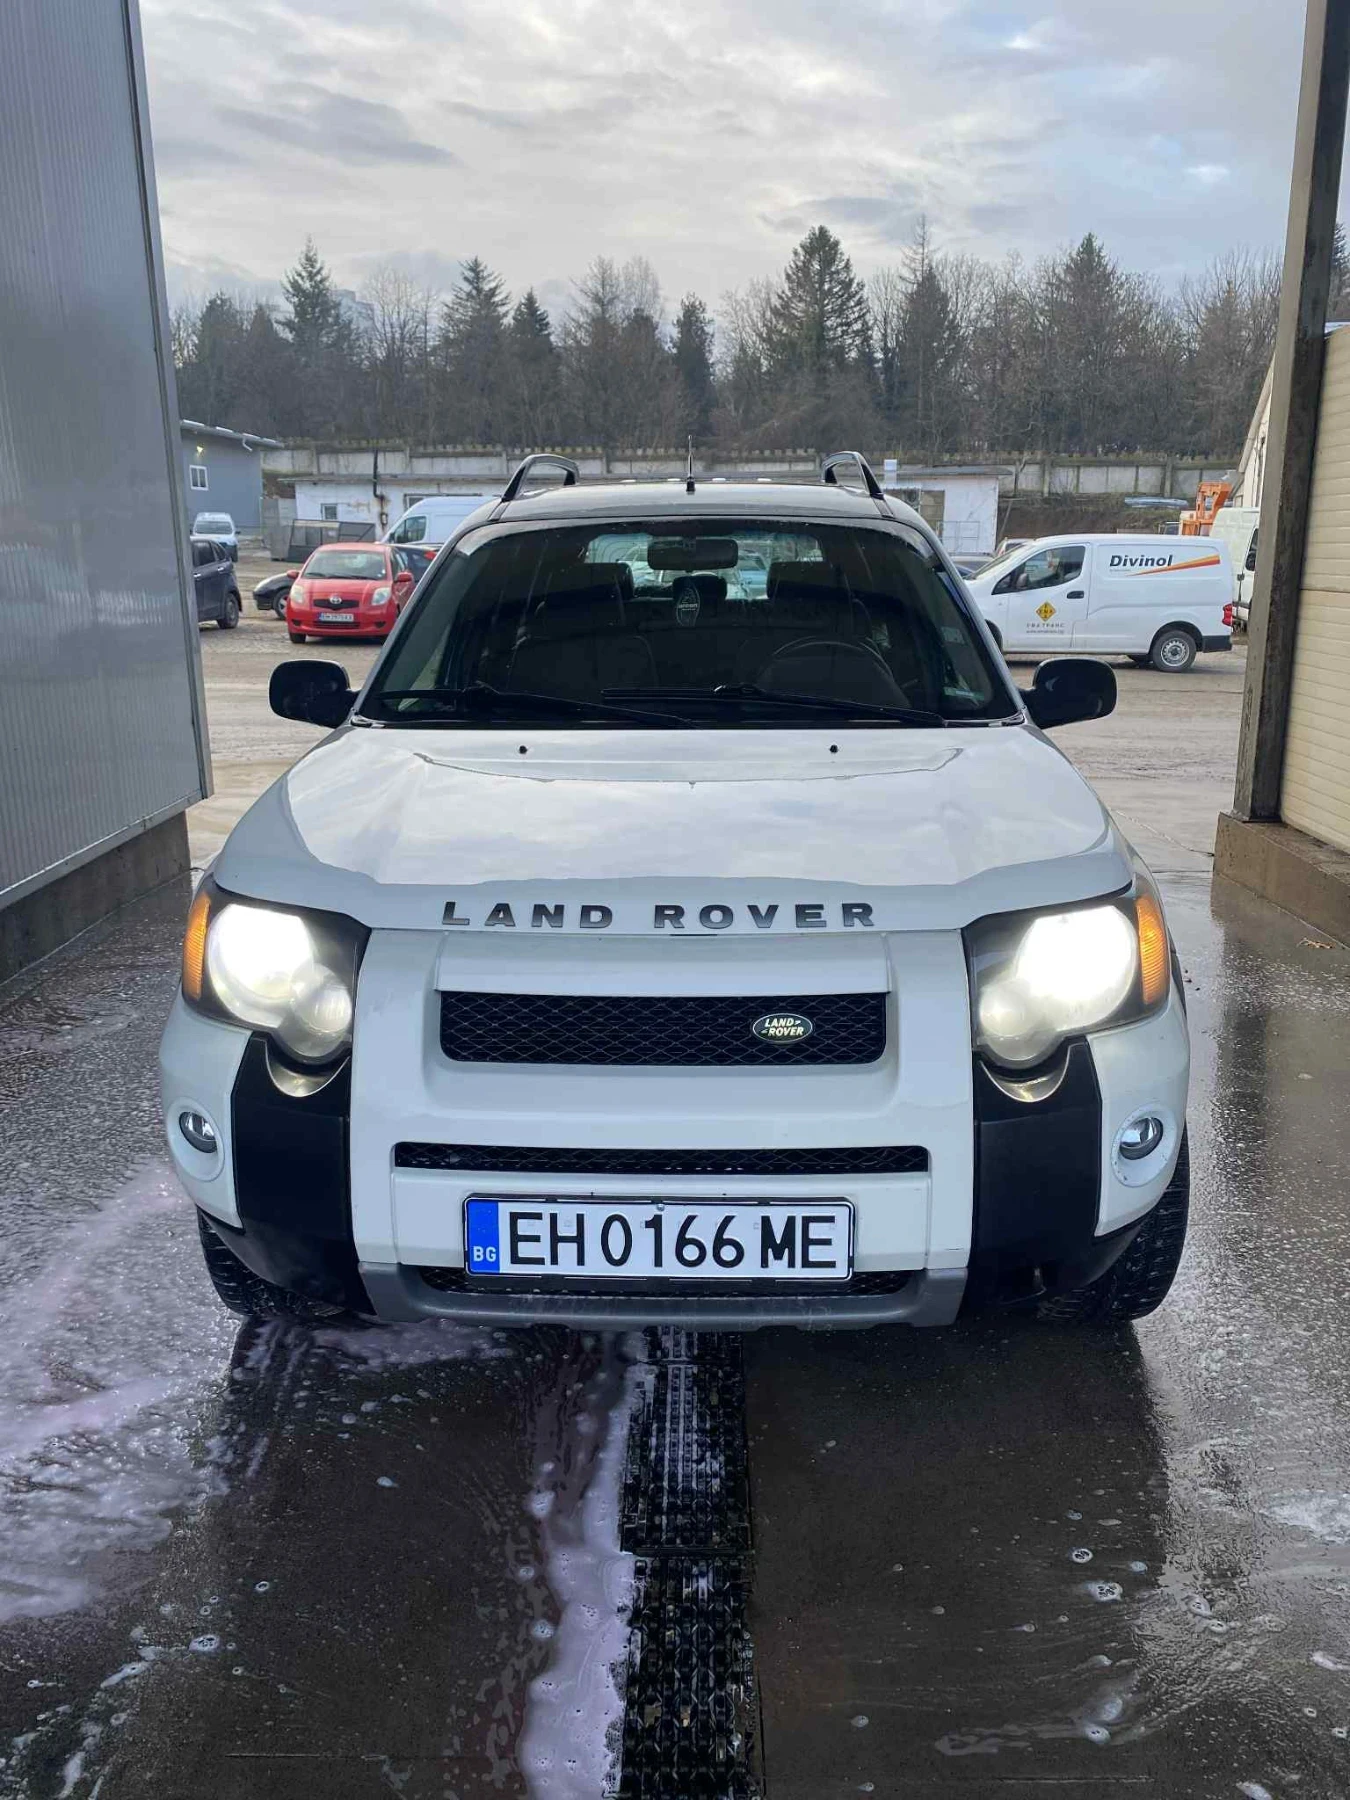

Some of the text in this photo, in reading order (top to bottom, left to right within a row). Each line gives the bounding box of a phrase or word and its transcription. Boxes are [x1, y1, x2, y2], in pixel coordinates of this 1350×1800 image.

[1109, 554, 1173, 567] Divinol
[441, 901, 875, 930] LAND ROVER
[764, 1018, 795, 1028] LAND
[768, 1027, 804, 1037] ROVER
[600, 1214, 746, 1269] 0166
[472, 1246, 497, 1263] BG
